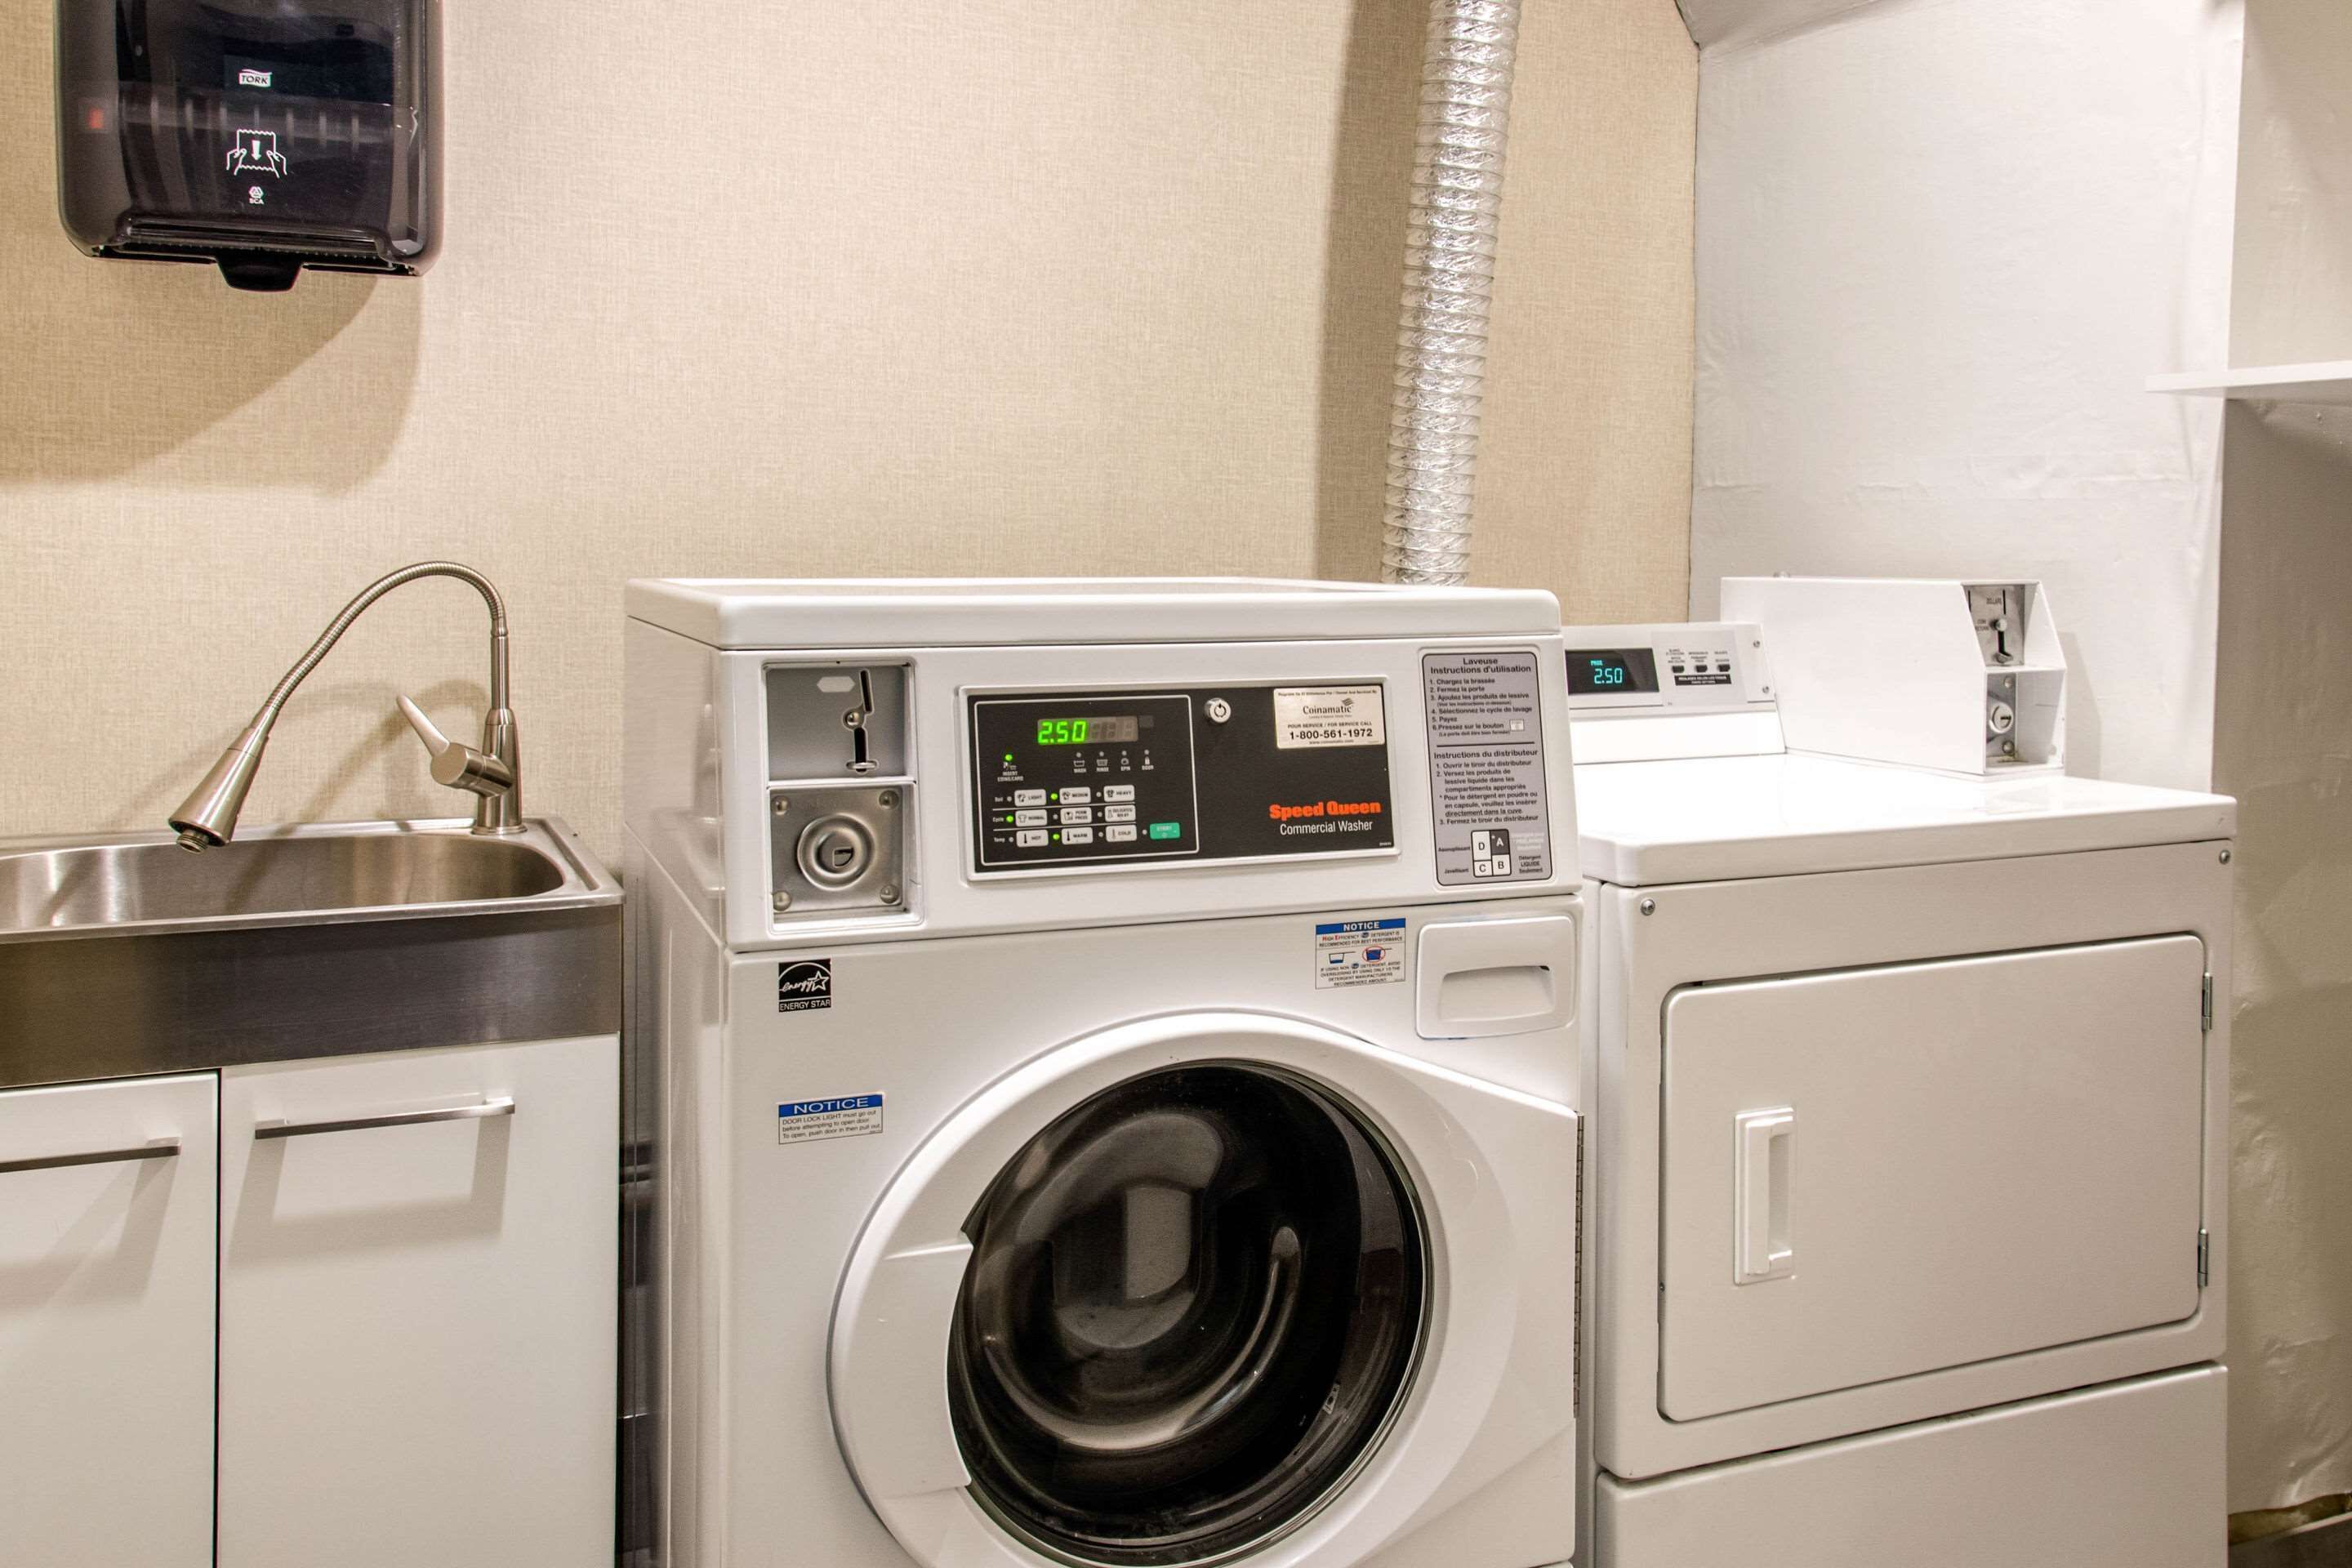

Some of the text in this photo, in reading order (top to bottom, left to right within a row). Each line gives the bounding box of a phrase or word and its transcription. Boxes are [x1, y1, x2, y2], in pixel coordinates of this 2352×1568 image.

[241, 74, 269, 85] TORK
[1594, 667, 1623, 684] 2.50
[1303, 705, 1352, 715] Coinamatic
[1038, 720, 1087, 745] 2.50
[1290, 728, 1373, 740] 1-800-561-1972
[1434, 751, 1480, 760] Instructions
[1446, 785, 1491, 793] compartiments
[1269, 801, 1381, 821] Speed Queen
[1280, 820, 1373, 835] Commercial Washer
[1496, 838, 1504, 846] A
[1479, 864, 1486, 872] C
[1498, 861, 1504, 869] B
[1343, 921, 1380, 931] NOTICE
[780, 999, 831, 1011] ENERGY STAR
[794, 1098, 869, 1114] NOTICE
[803, 1122, 832, 1130] attempting
